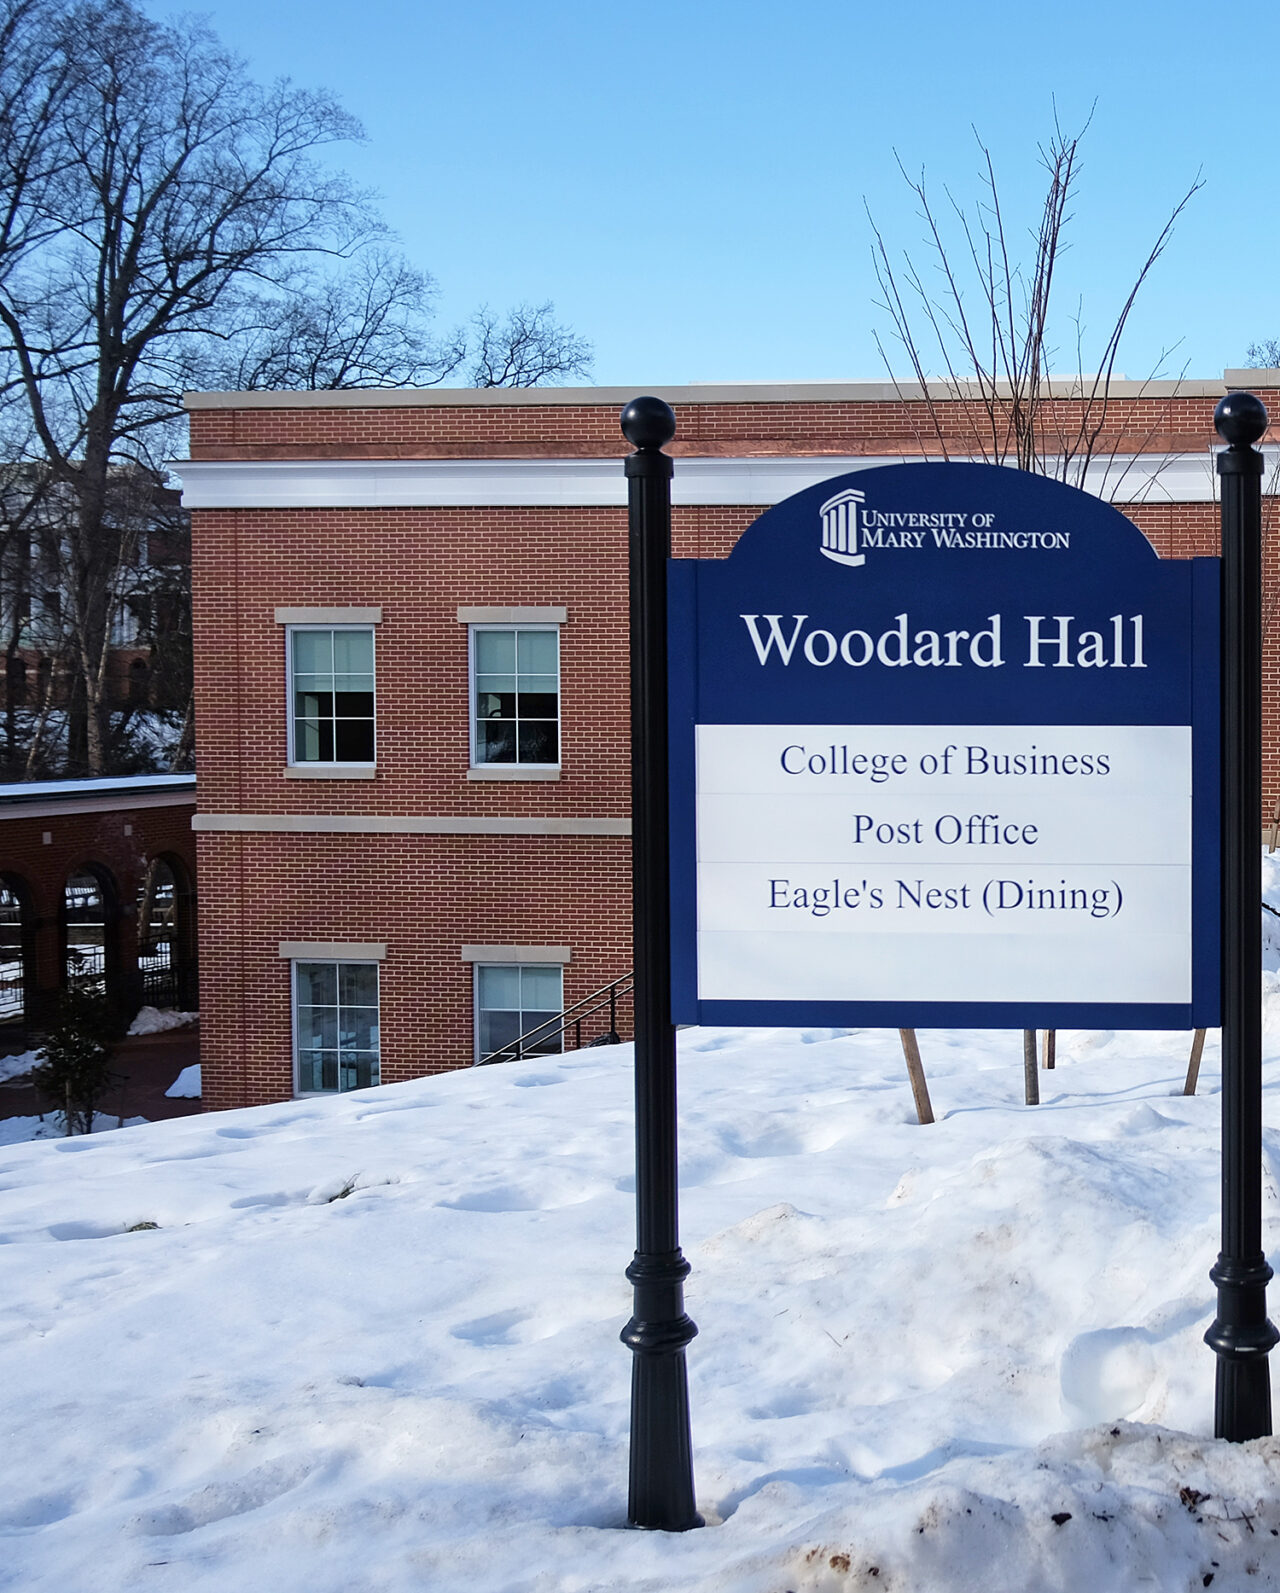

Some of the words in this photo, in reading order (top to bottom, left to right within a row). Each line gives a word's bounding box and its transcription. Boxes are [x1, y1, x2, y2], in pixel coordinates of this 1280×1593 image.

[861, 510, 967, 527] UNIVERSITY
[972, 513, 995, 527] OF
[861, 528, 926, 548] MARY
[931, 528, 1071, 549] WASHINGTON
[739, 613, 1006, 668] Woodard
[1023, 614, 1148, 668] Hall
[780, 744, 908, 783] College
[919, 744, 958, 775] of
[965, 745, 1111, 776] Business
[853, 814, 923, 844] Post
[934, 814, 1038, 845] Office
[769, 878, 884, 917] Eagle's
[896, 879, 971, 909] Nest
[982, 879, 1123, 919] (Dining)
